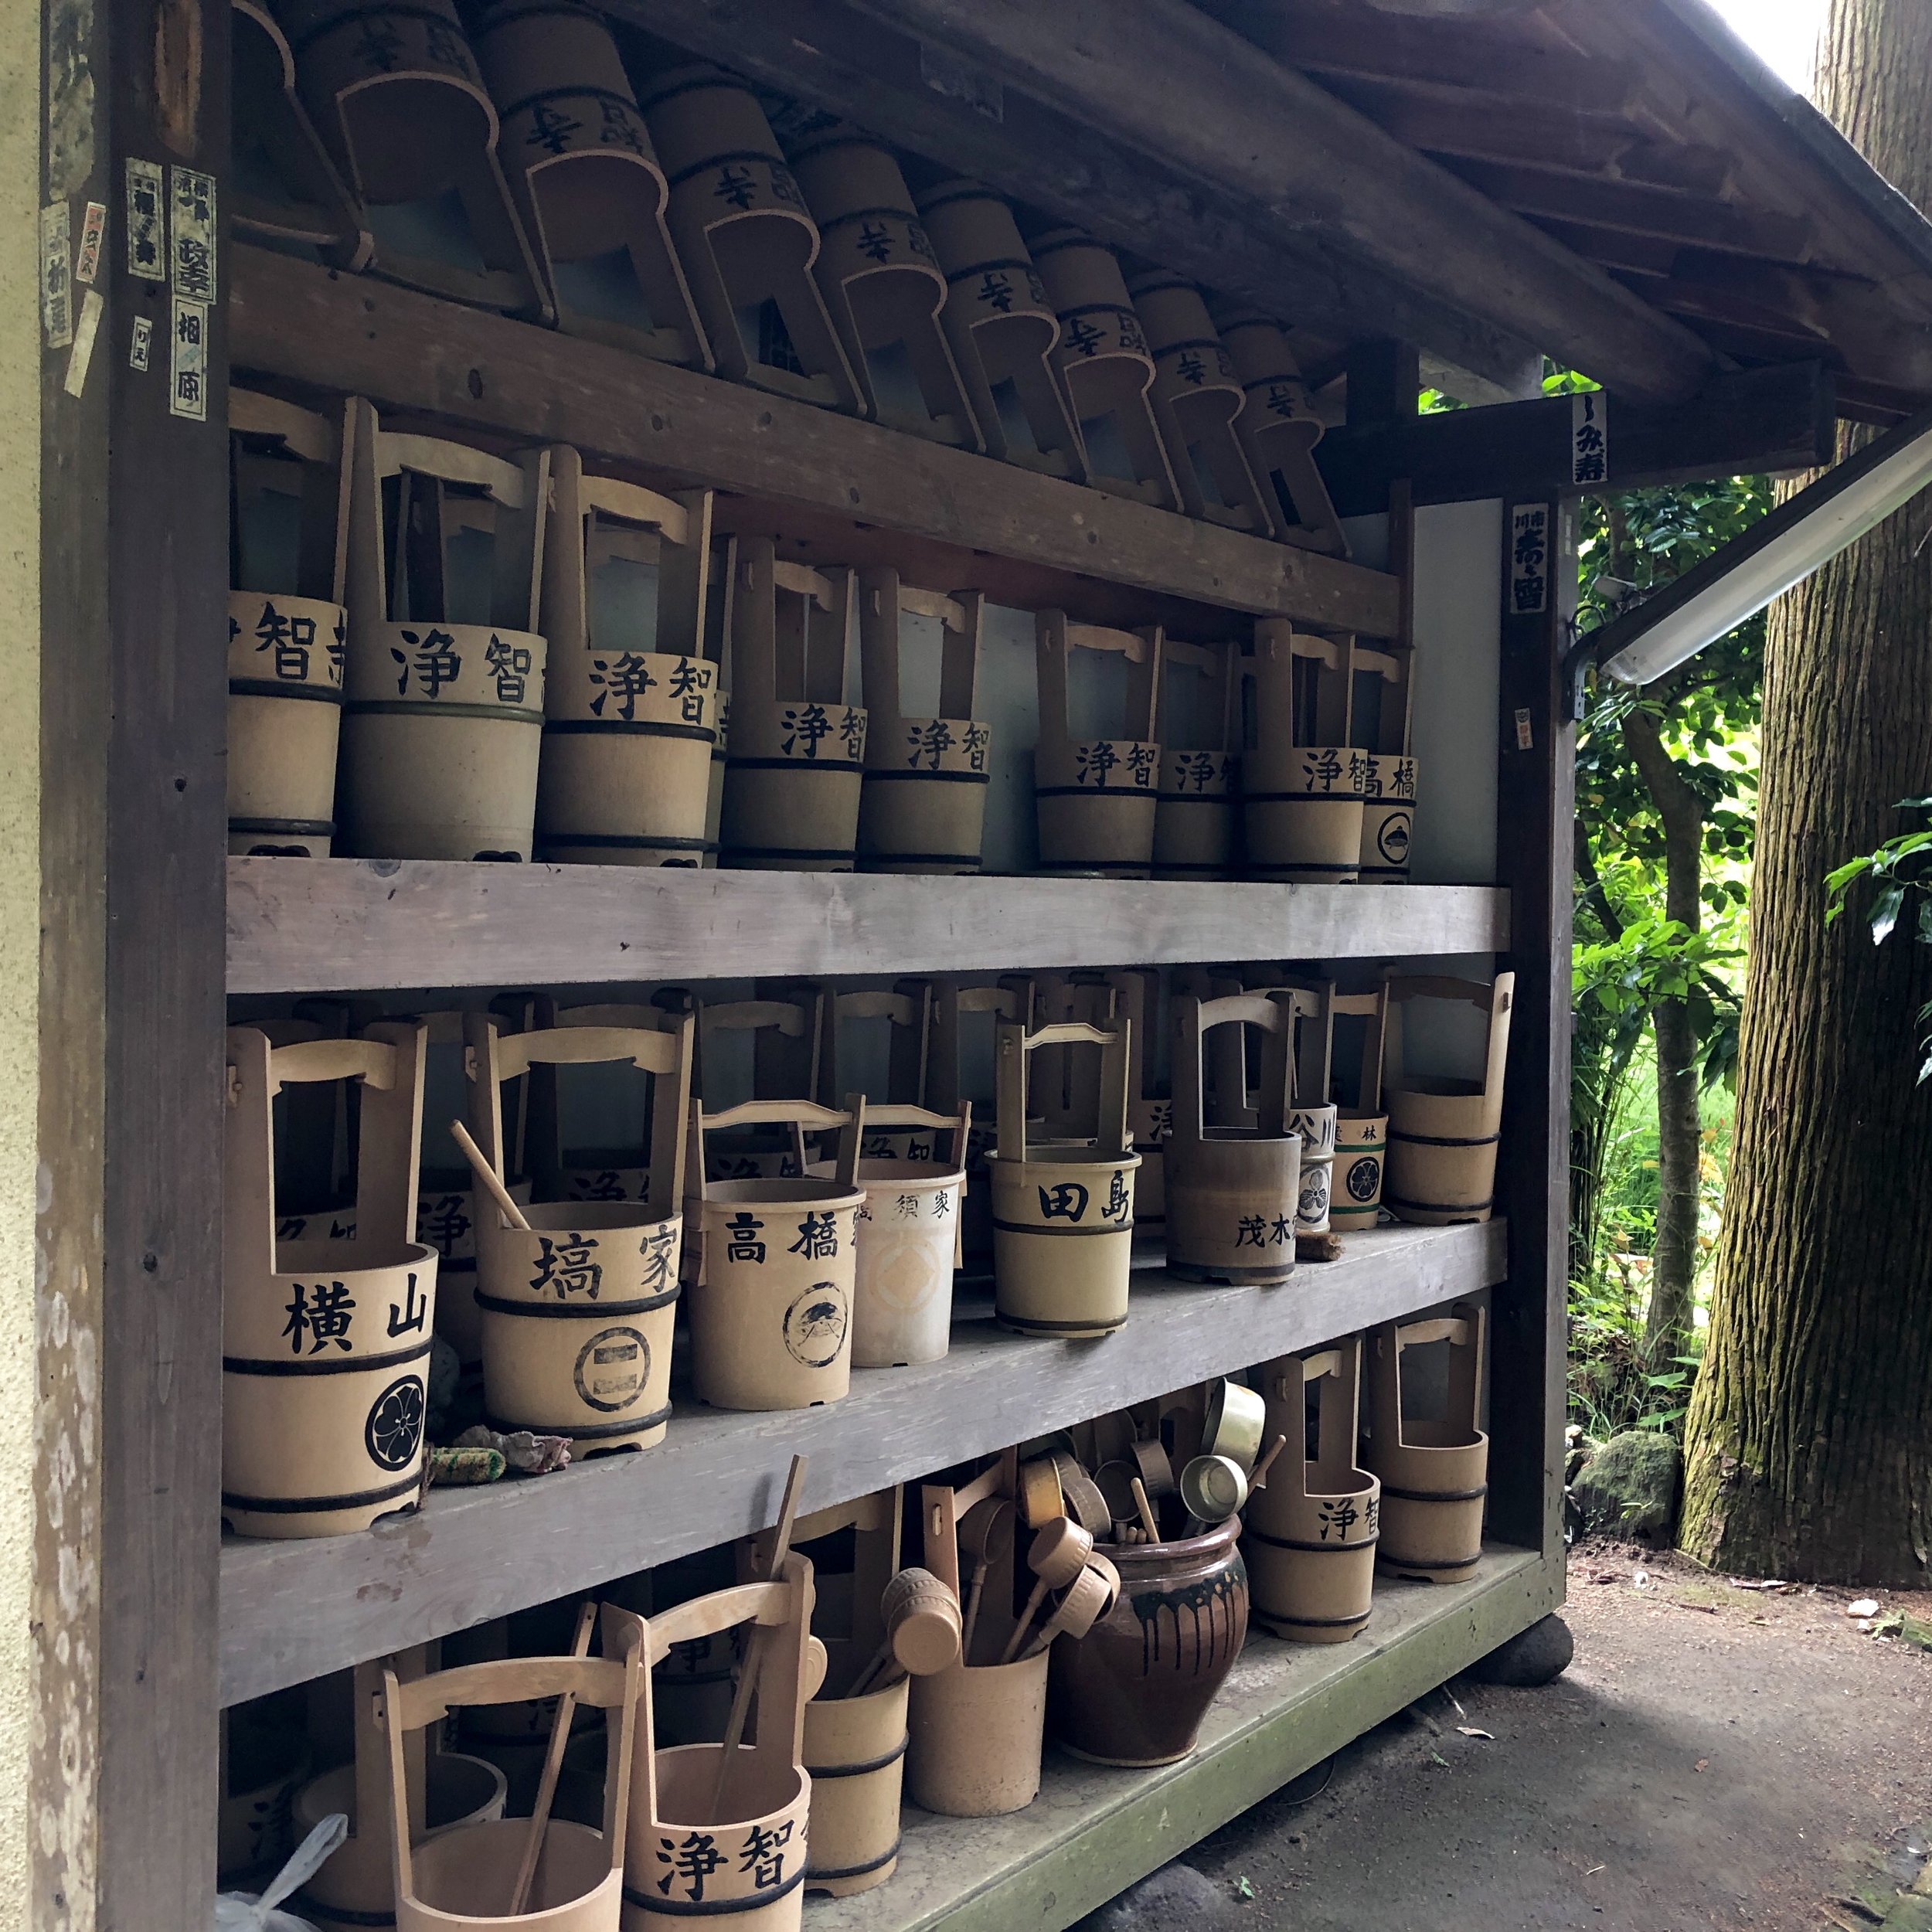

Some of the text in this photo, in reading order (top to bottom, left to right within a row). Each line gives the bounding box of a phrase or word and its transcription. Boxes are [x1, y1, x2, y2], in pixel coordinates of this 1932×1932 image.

[178, 311, 200, 401] 相原
[230, 602, 346, 685] 智寺
[391, 628, 532, 702] 浄智
[589, 651, 712, 726] 浄智
[781, 704, 867, 763] 浄智
[906, 719, 989, 771] 浄智
[1075, 741, 1156, 787] 浄智
[1302, 749, 1366, 792] 浄智
[1039, 1169, 1129, 1223] 田島
[725, 1210, 839, 1264] 高橋
[1235, 1213, 1297, 1248] 茂木
[281, 1273, 427, 1355] 横山
[1318, 1496, 1379, 1541] 浄智
[656, 1819, 795, 1902] 浄智
